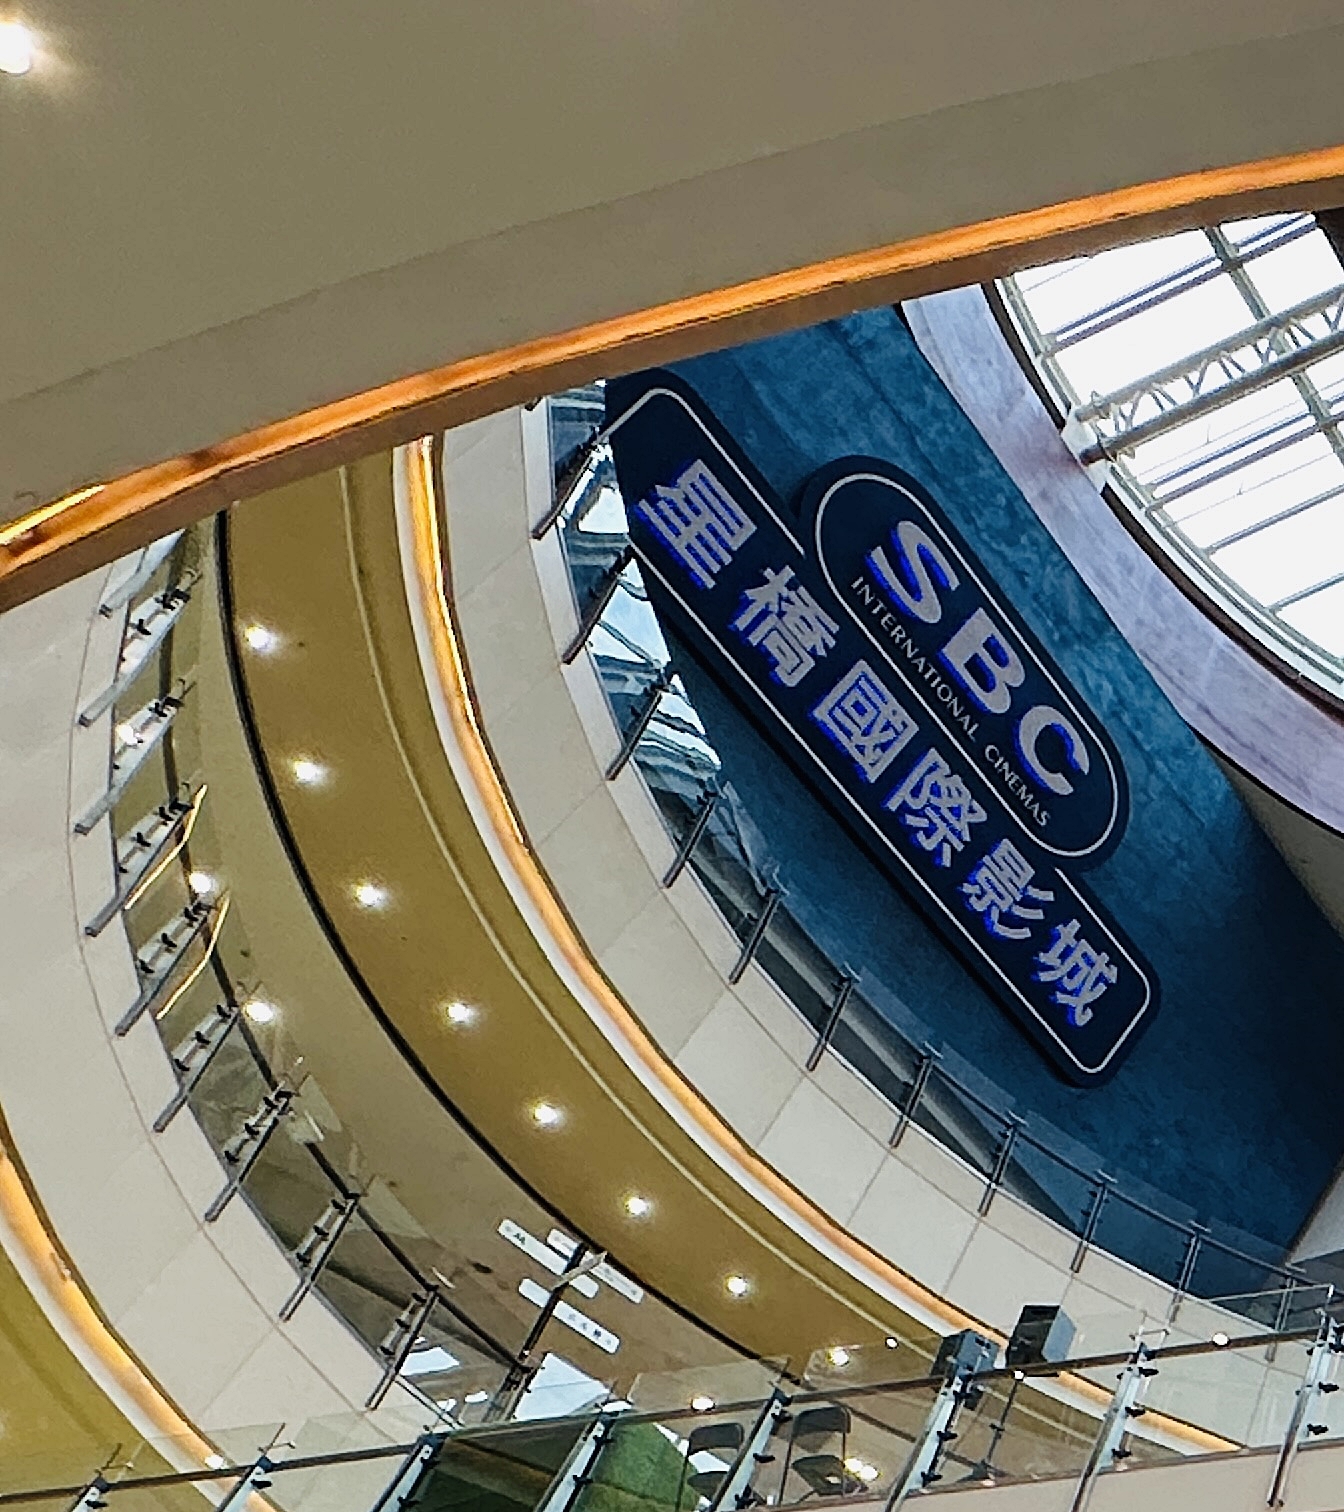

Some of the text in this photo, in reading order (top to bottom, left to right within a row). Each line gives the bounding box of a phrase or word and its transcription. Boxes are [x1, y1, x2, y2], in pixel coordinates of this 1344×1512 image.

[636, 458, 1118, 1026] 星橋國際影城
[850, 576, 1050, 827] INTERNATIONAL CINEMAS
[867, 521, 1089, 796] SBC
